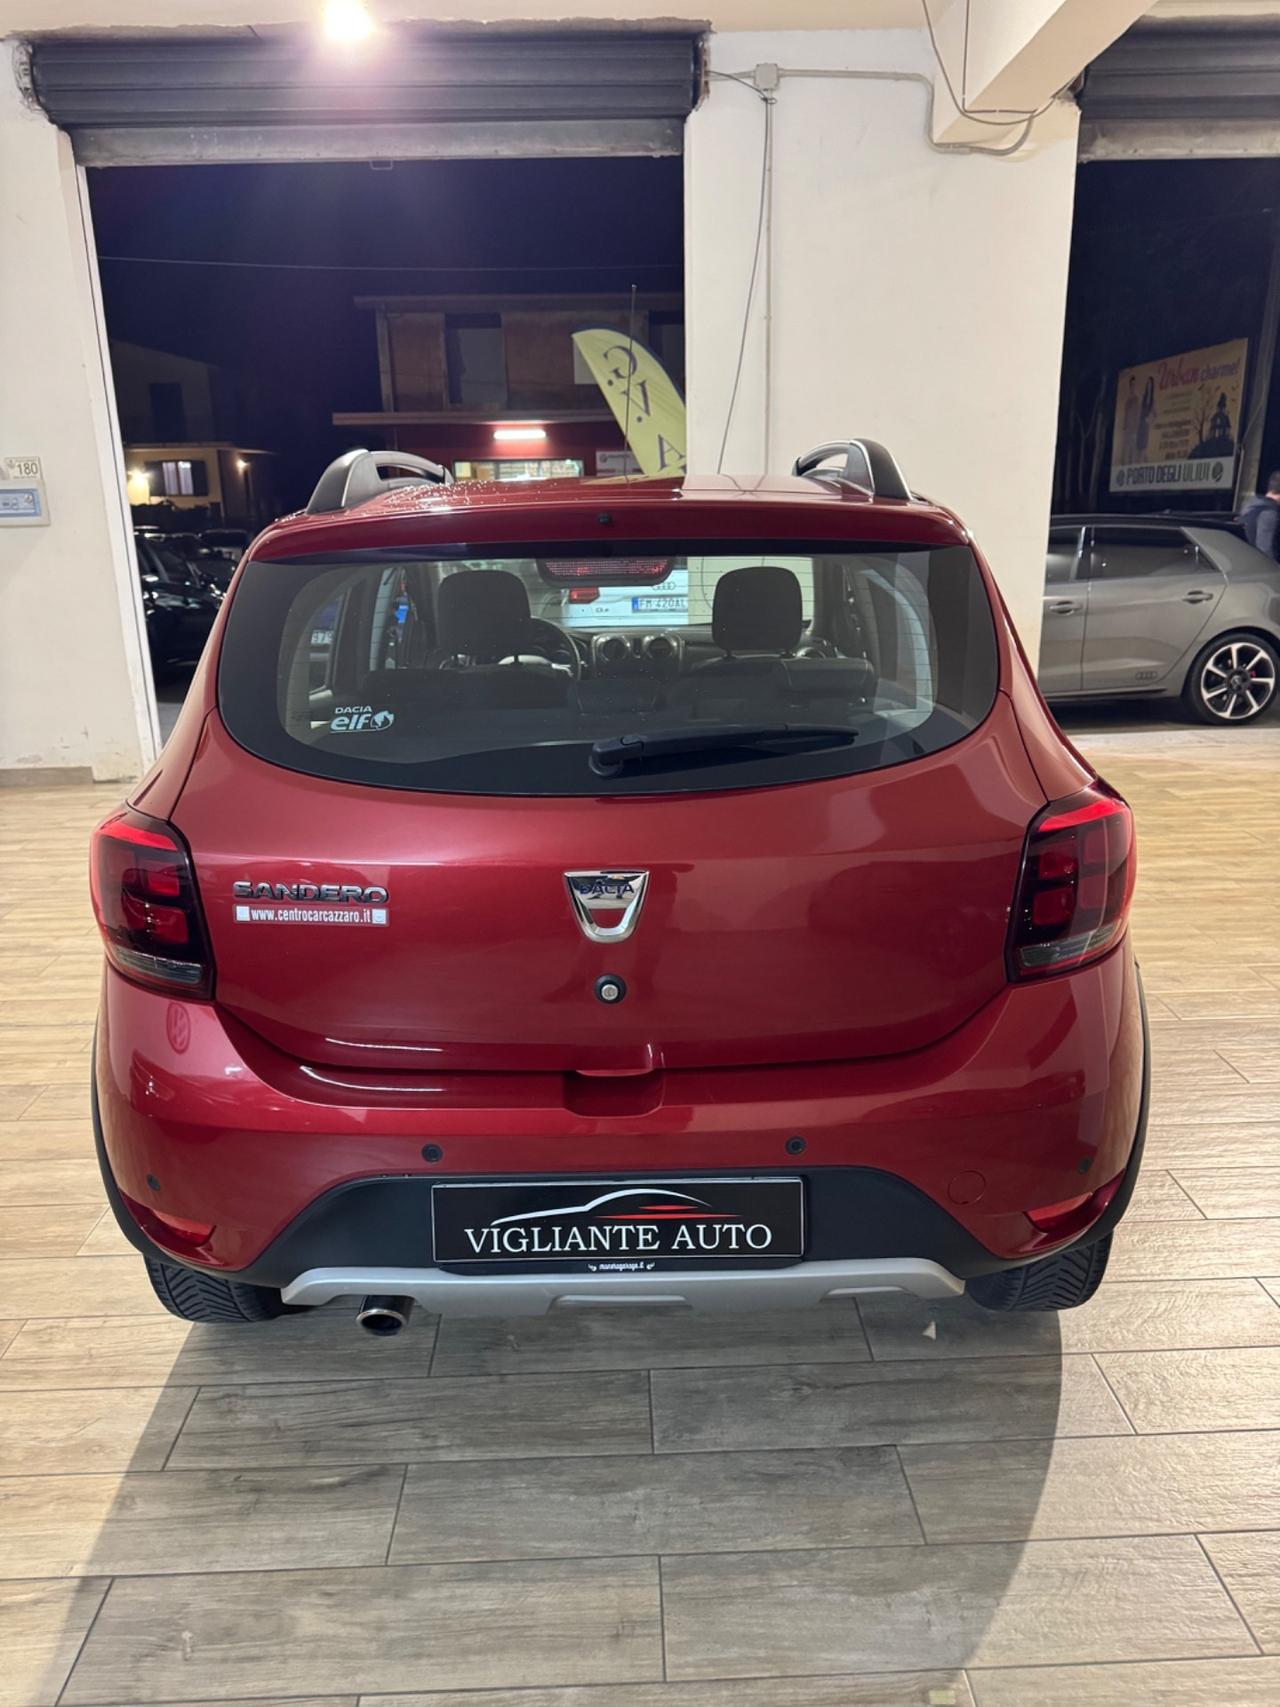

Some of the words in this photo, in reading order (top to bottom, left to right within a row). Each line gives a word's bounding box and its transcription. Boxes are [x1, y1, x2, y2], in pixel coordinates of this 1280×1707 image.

[17, 462, 39, 475] 180
[1126, 465, 1155, 486] PORTO
[1156, 463, 1182, 484] DEGLI
[335, 705, 373, 714] DACIA
[330, 713, 372, 731] elf
[233, 880, 389, 903] SANDERO
[579, 881, 635, 895] DACIA
[251, 907, 371, 923] www.centrocarcazzaro.it
[464, 1224, 661, 1254] VIGLIANTE
[671, 1223, 773, 1250] AUTO
